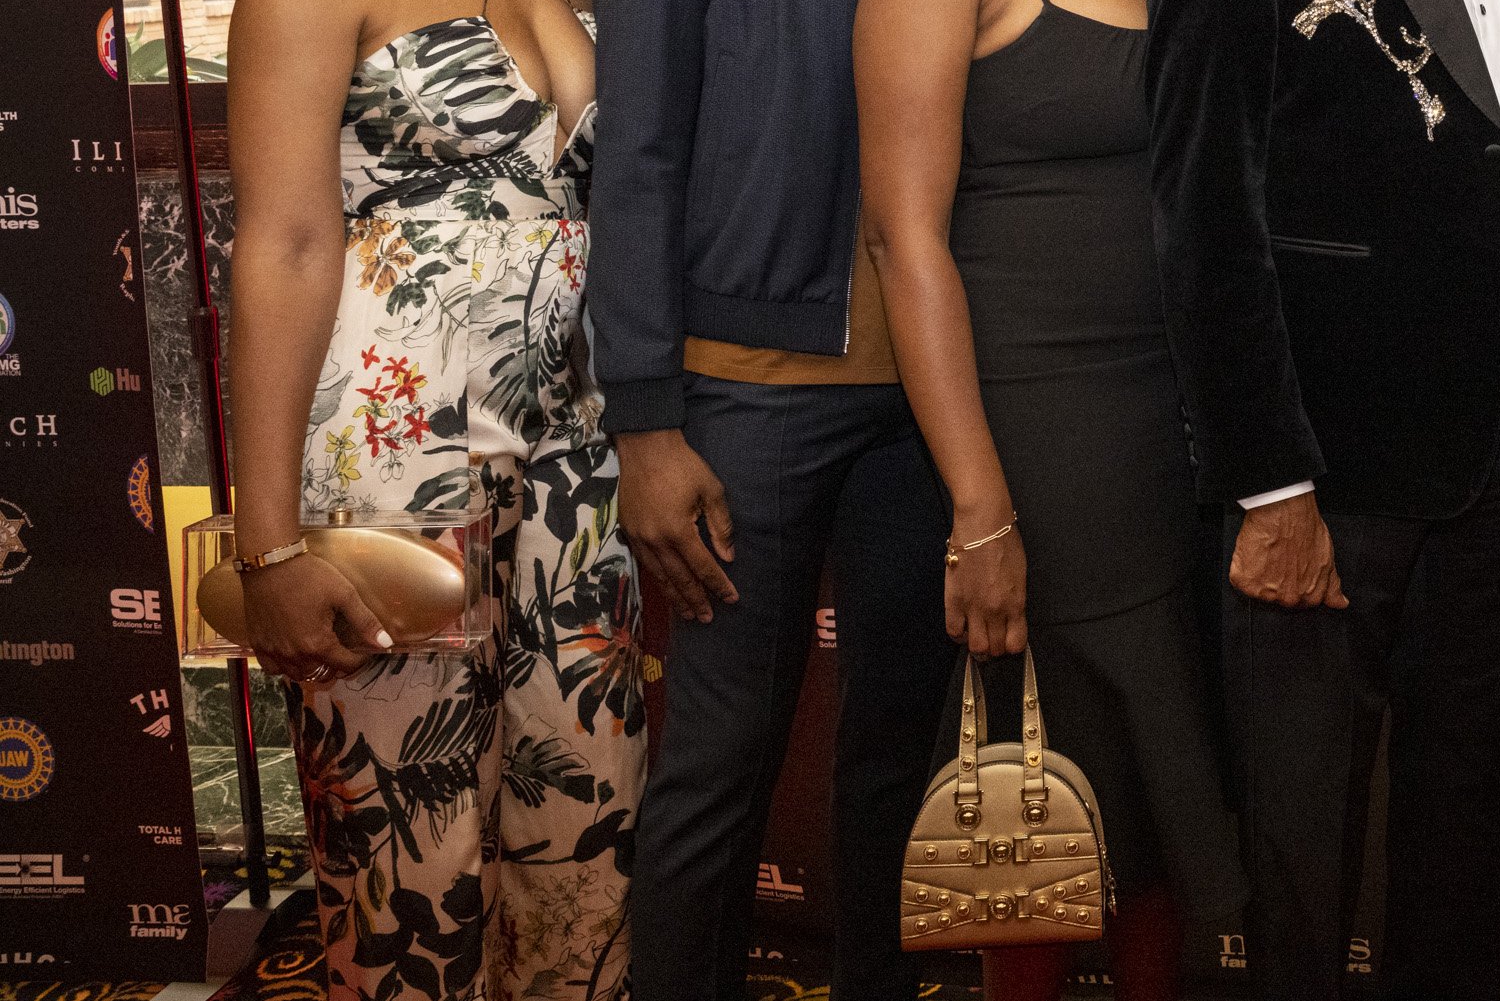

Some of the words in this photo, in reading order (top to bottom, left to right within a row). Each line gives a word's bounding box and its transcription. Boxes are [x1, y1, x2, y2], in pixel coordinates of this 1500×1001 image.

[0, 218, 39, 230] ters
[0, 359, 20, 371] MG
[112, 620, 142, 629] Solutions
[143, 620, 153, 628] for
[0, 640, 75, 666] tington
[138, 825, 172, 834] TOTAL
[154, 836, 182, 845] CARE
[0, 854, 85, 885] EEL
[130, 926, 188, 940] family
